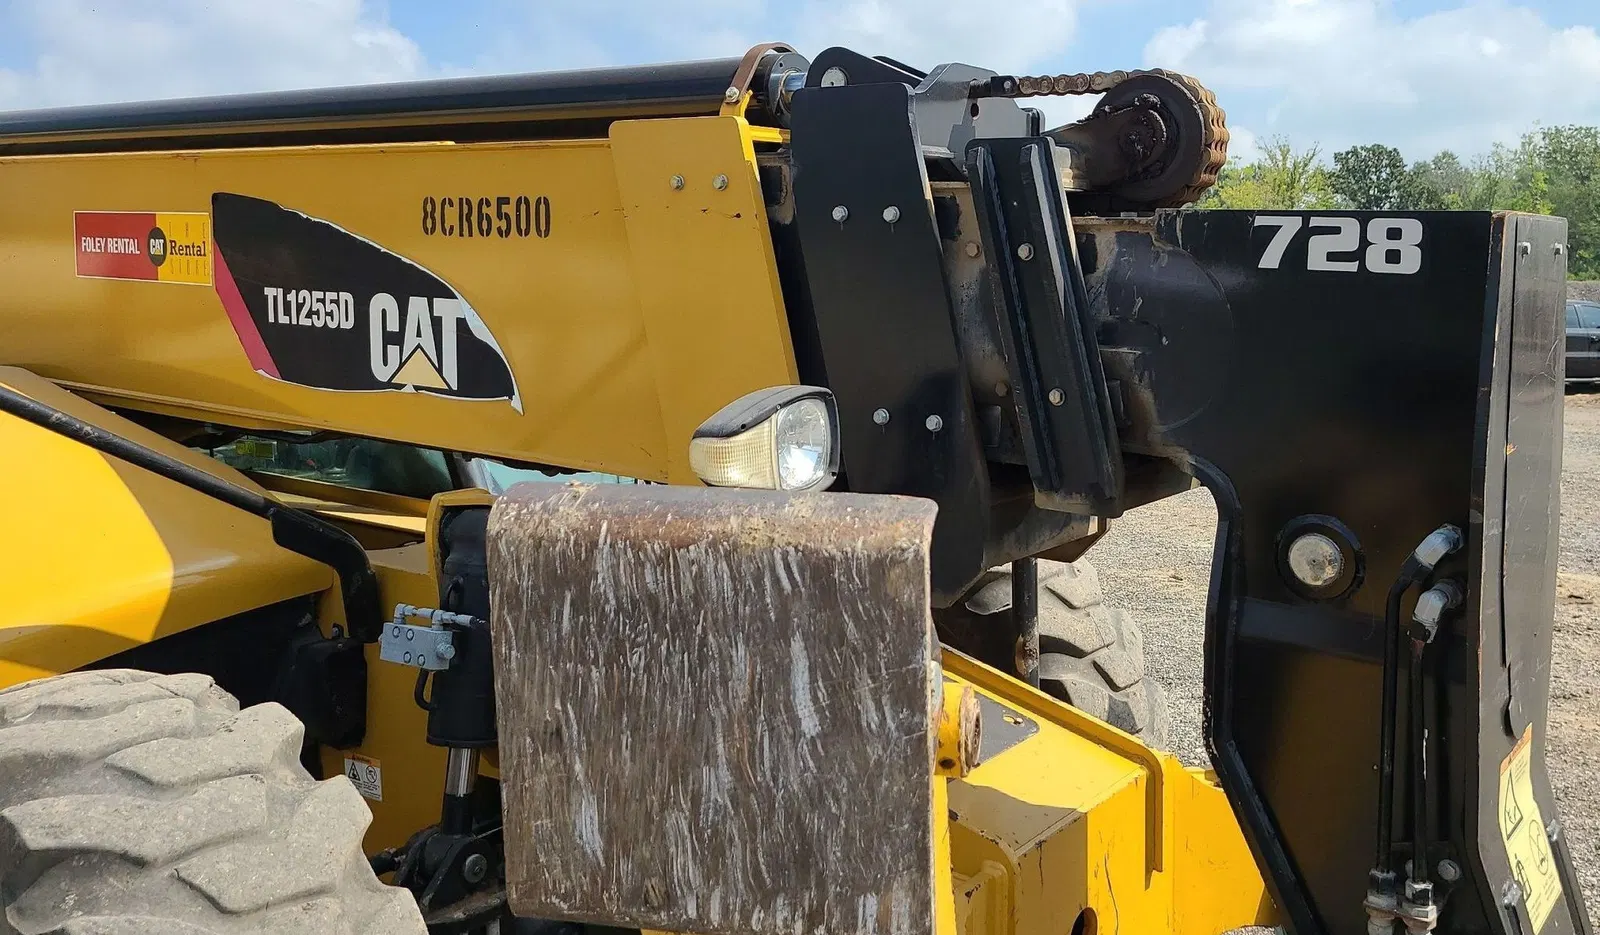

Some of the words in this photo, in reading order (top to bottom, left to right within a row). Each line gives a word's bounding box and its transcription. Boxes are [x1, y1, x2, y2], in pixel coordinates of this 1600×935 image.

[422, 196, 551, 238] 8CR6500
[81, 236, 106, 253] FOLEY
[107, 237, 140, 254] RENTAL
[149, 238, 164, 255] CAT
[169, 239, 207, 257] Rental
[1253, 215, 1423, 275] 728
[264, 287, 355, 329] TL1255D
[369, 292, 465, 390] CAT
